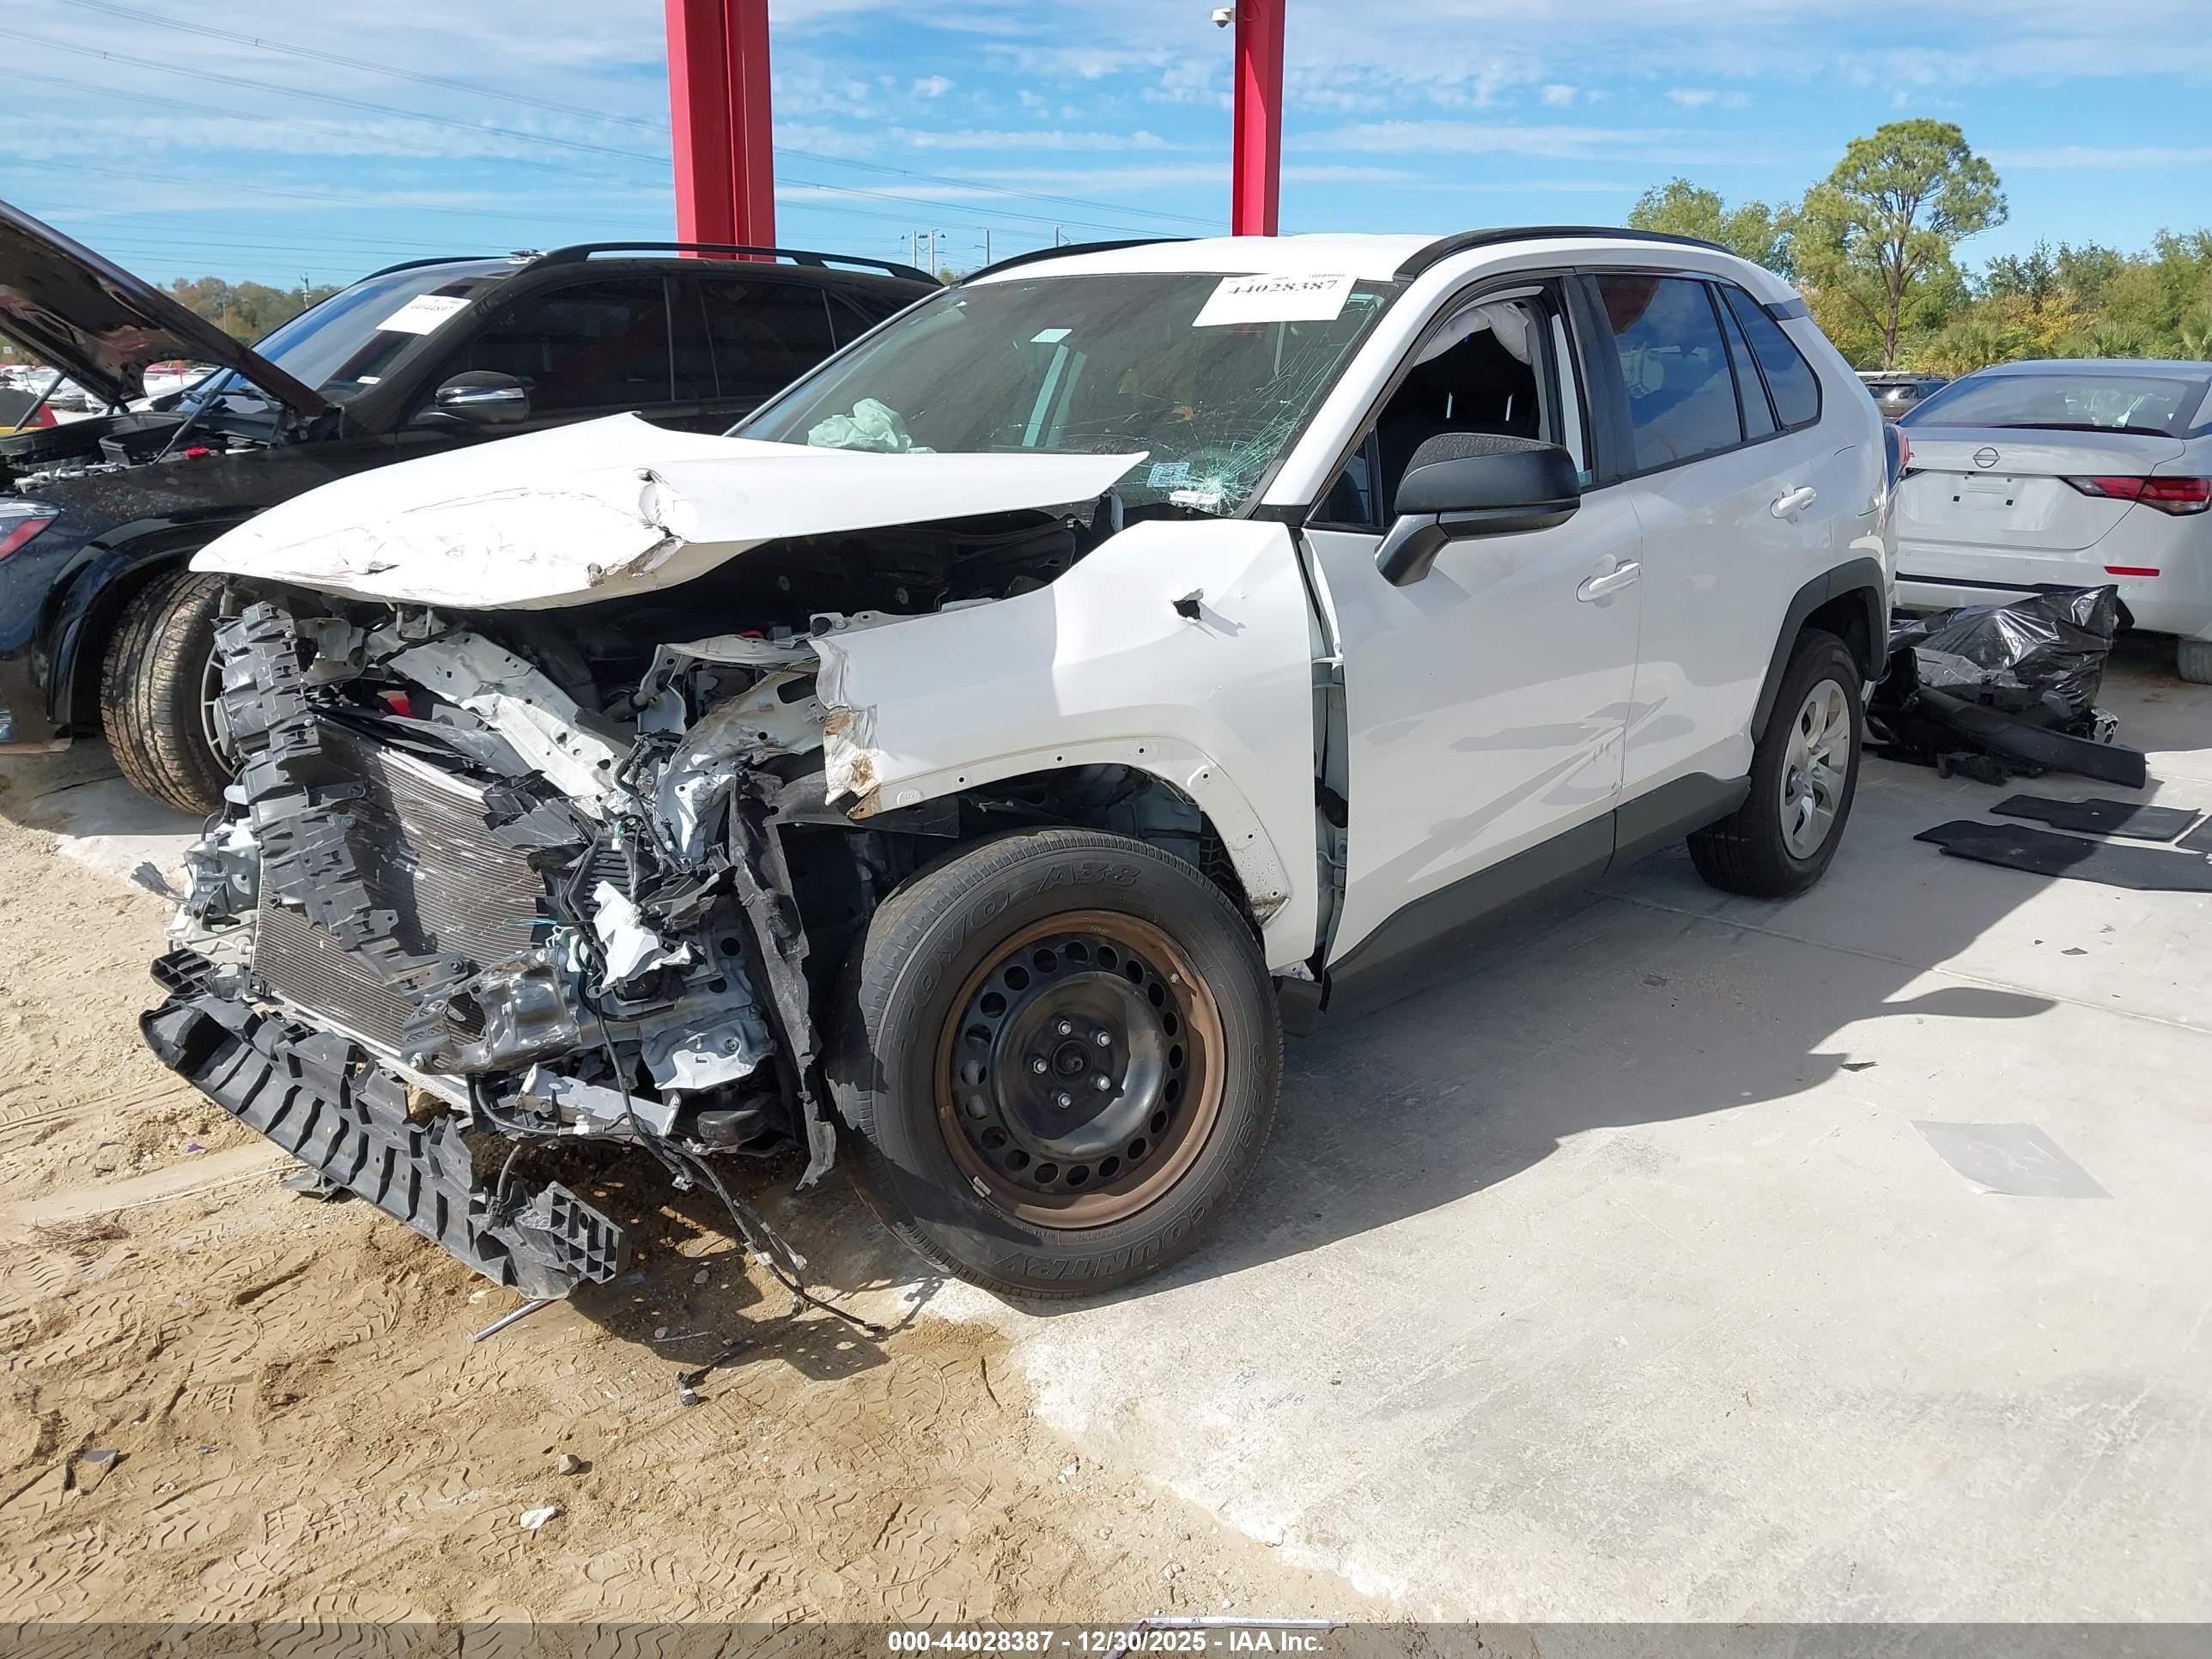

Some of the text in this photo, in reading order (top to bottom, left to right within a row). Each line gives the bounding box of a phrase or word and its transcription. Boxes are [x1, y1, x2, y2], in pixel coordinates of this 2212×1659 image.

[1228, 279, 1338, 295] 44028387
[1037, 863, 1140, 893] A38
[898, 889, 1010, 1053] TOYO
[994, 1040, 1270, 1280] OPEN COUNTRY
